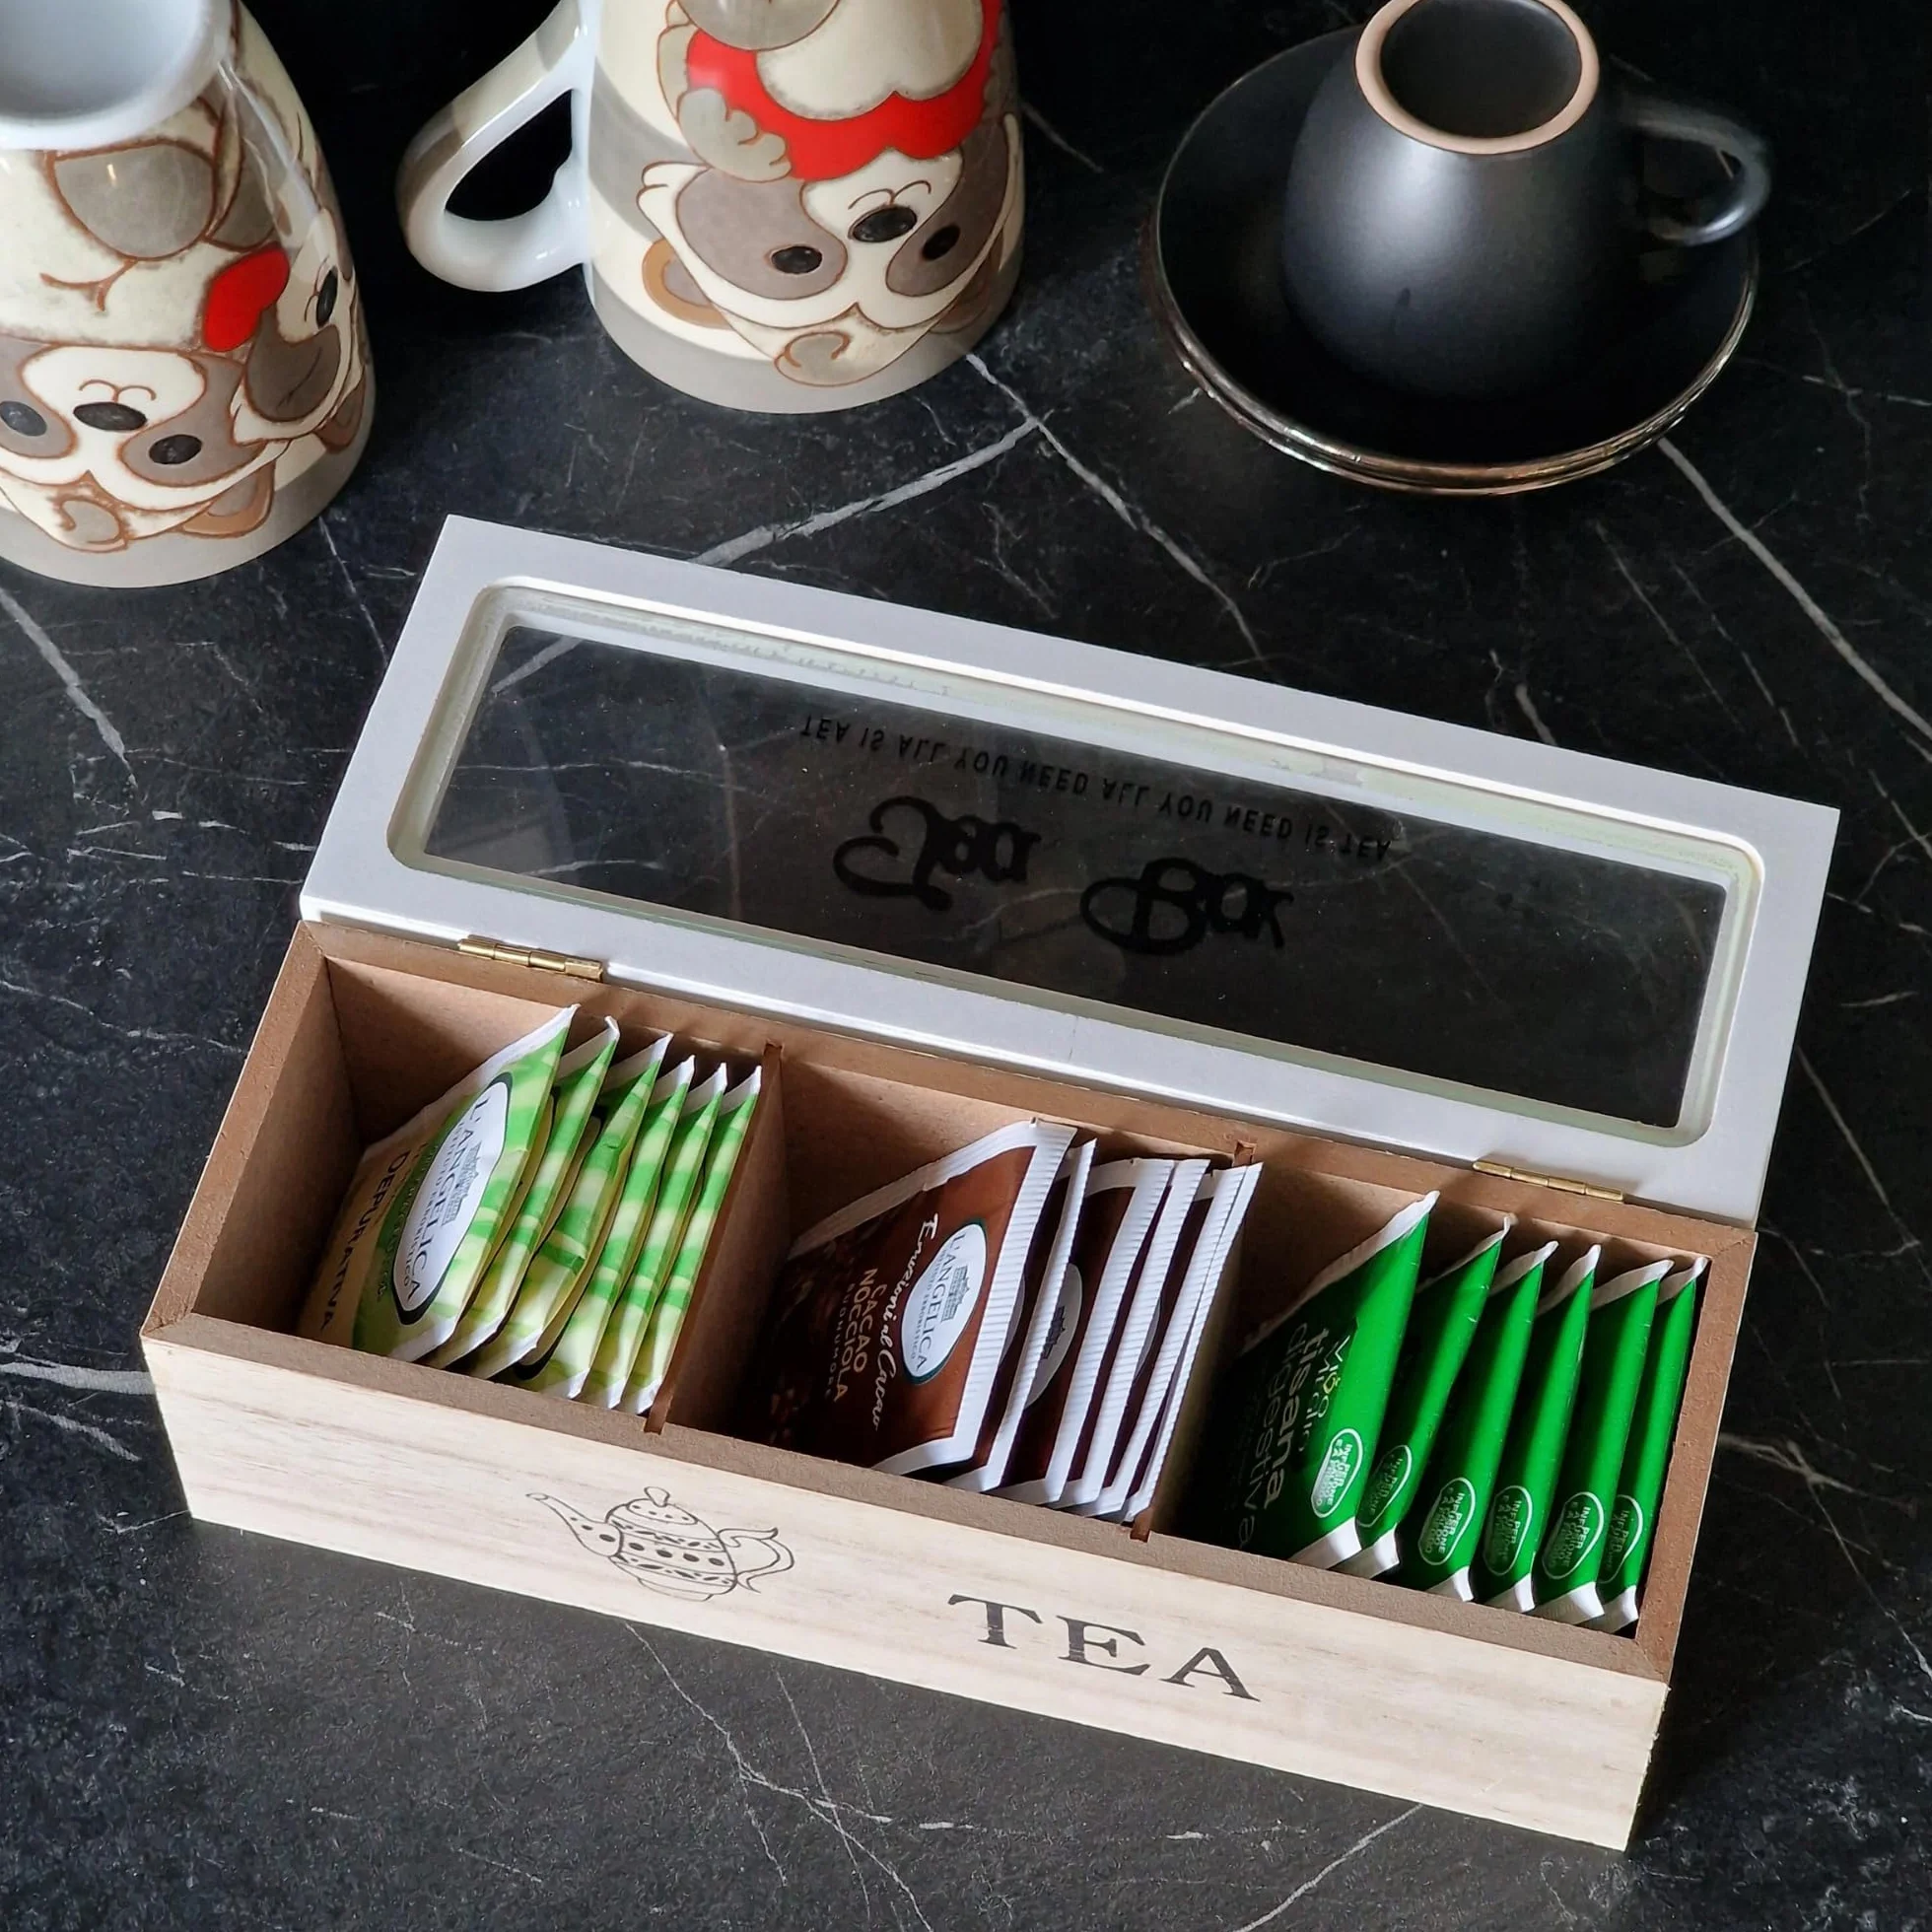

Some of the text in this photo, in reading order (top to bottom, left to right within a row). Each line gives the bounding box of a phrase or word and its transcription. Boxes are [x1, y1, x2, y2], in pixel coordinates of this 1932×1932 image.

[406, 1098, 490, 1302] L'ANGELICA
[833, 1268, 879, 1403] NOCCIOLA
[853, 1283, 888, 1373] CACAO
[879, 1323, 894, 1349] al
[916, 1233, 967, 1371] L'ANGELICA
[871, 1349, 897, 1431] Cacao
[1239, 1322, 1308, 1550] digestiva
[1264, 1328, 1330, 1510] tisana
[1576, 1527, 1591, 1550] PER
[948, 1593, 1262, 1702] TEA
